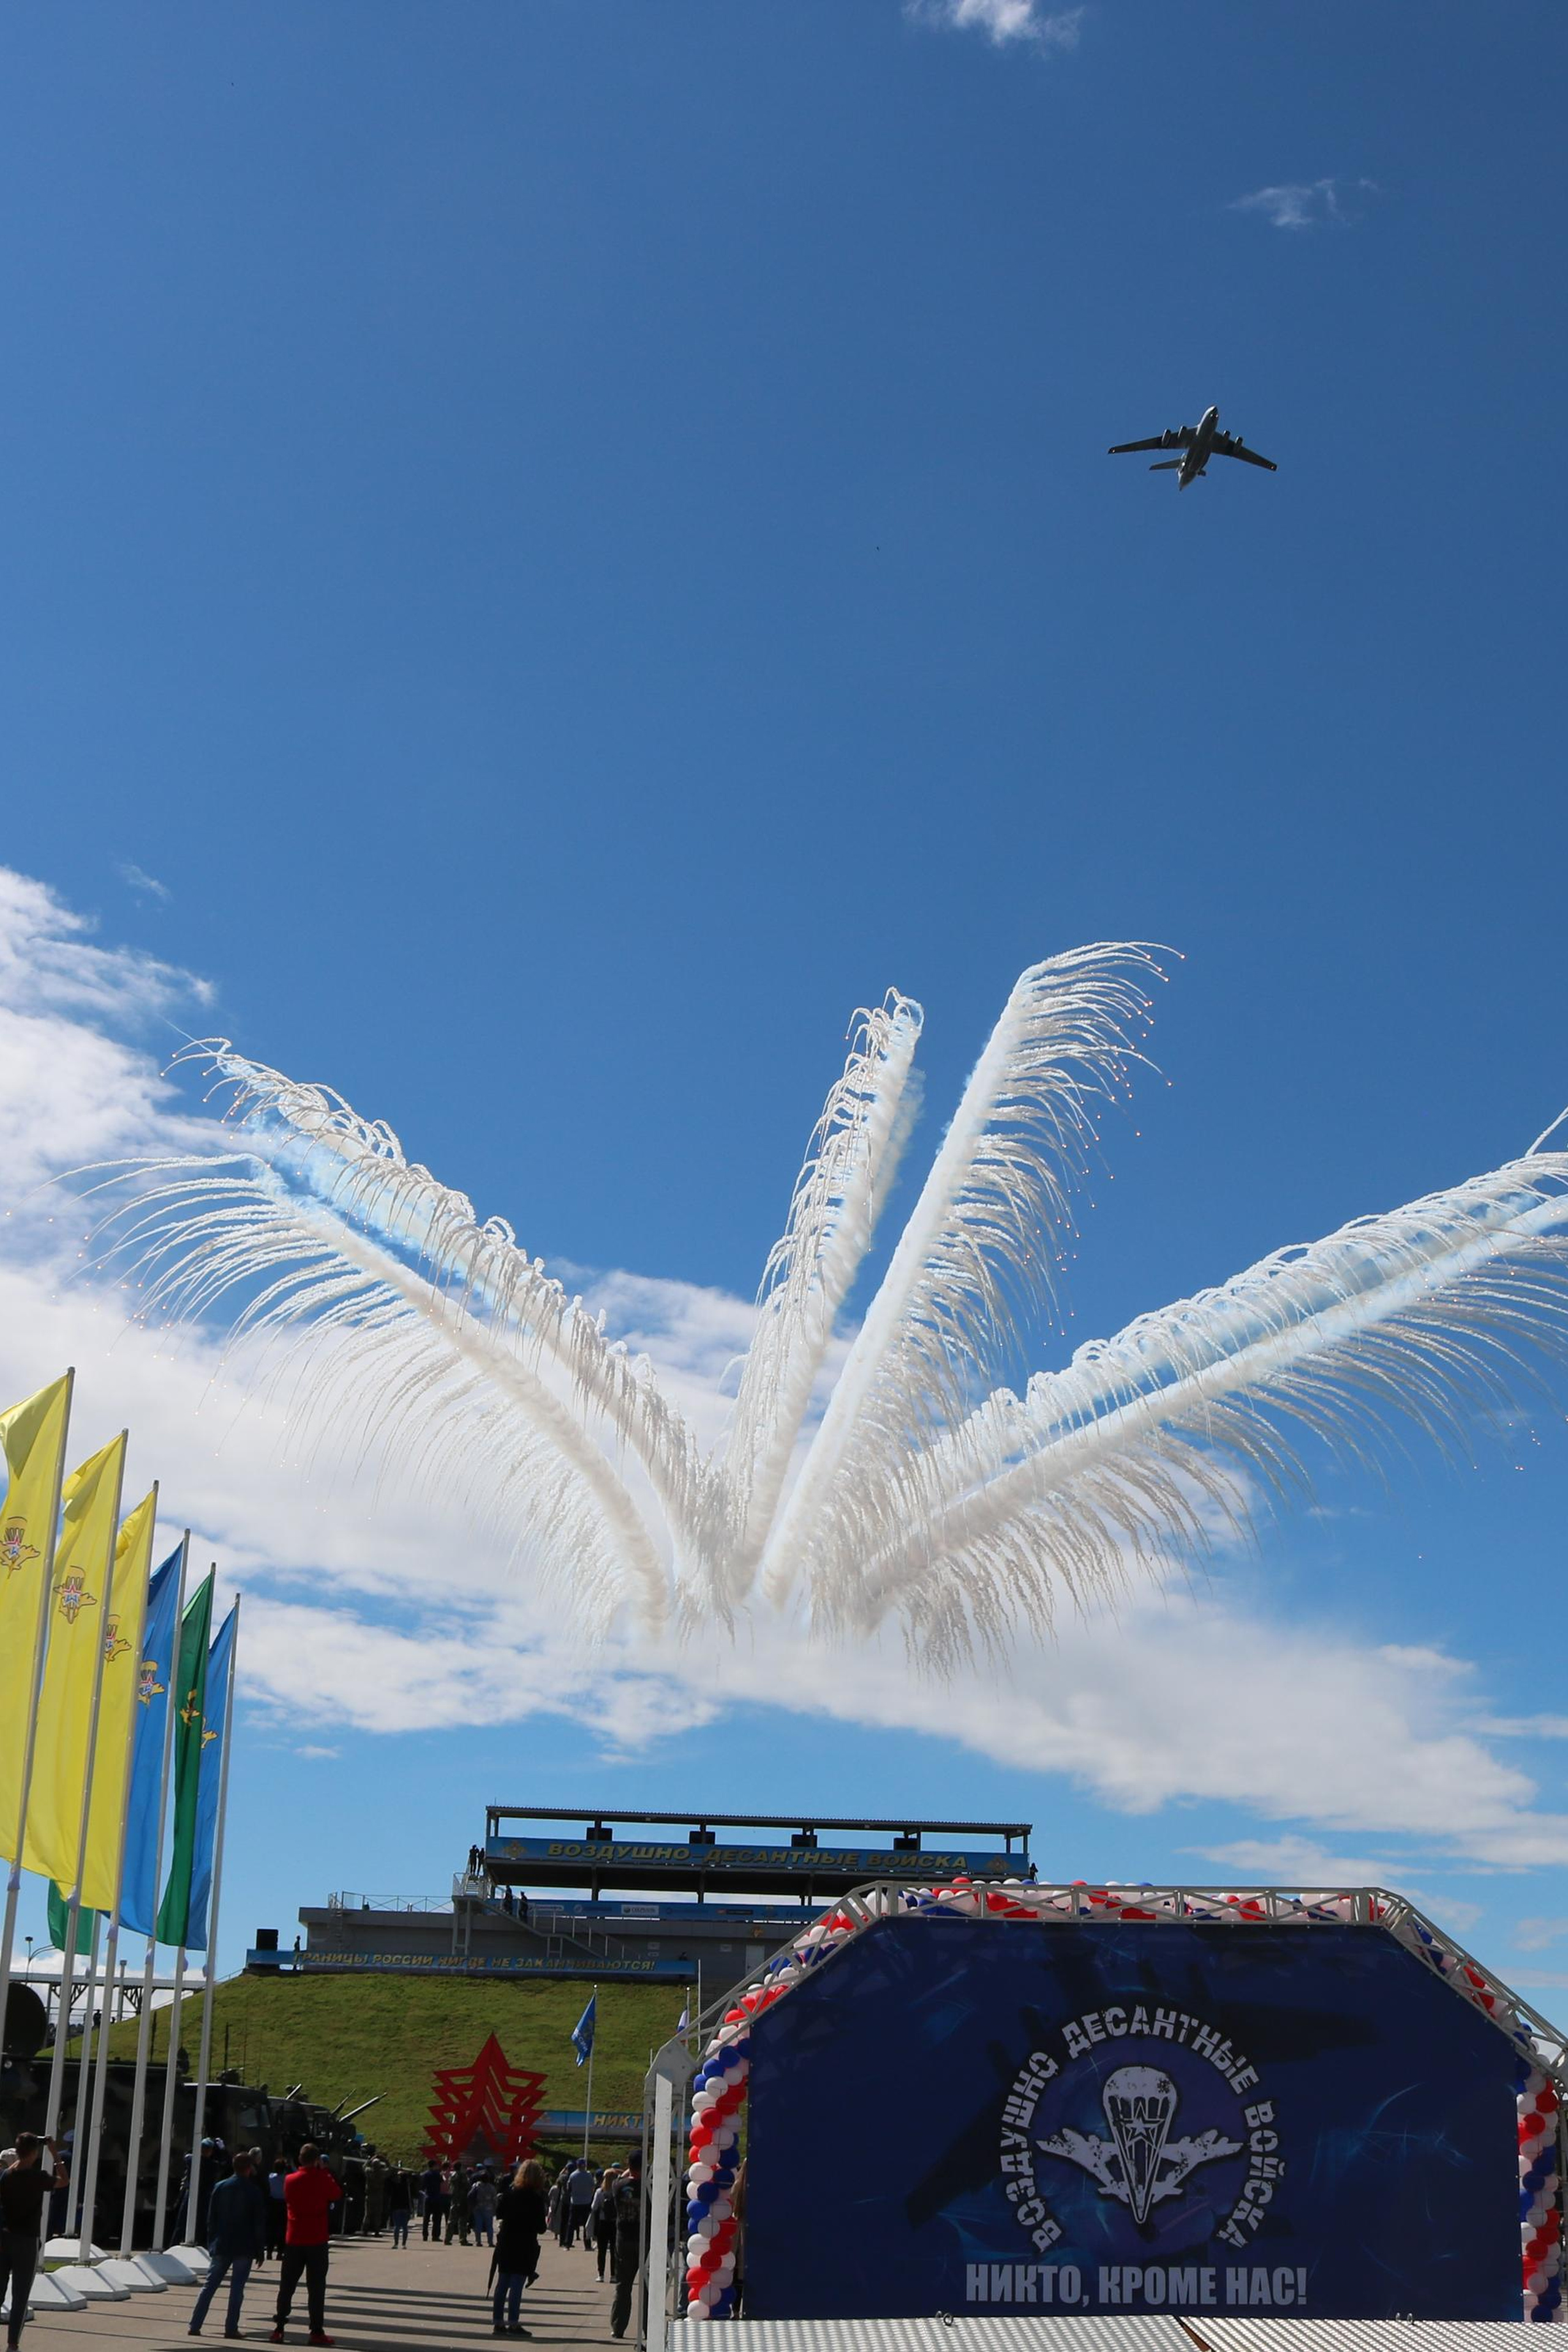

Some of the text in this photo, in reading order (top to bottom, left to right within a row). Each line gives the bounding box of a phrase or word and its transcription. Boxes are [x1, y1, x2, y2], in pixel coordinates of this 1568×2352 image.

[548, 1843, 860, 1866] ВОЗДУШНО-ДЕСАНТНЫЕ
[294, 1952, 368, 1964] ГРАНИЦЫ
[372, 1954, 433, 1965] РОССИИ
[492, 1958, 511, 1968] НЕ
[1000, 2004, 1286, 2253] ВОЗДУШНО ДЕСАНТНЫЕ ВОЙСКА
[966, 2263, 1308, 2308] НИКТО, КРОМЕ НАС!
